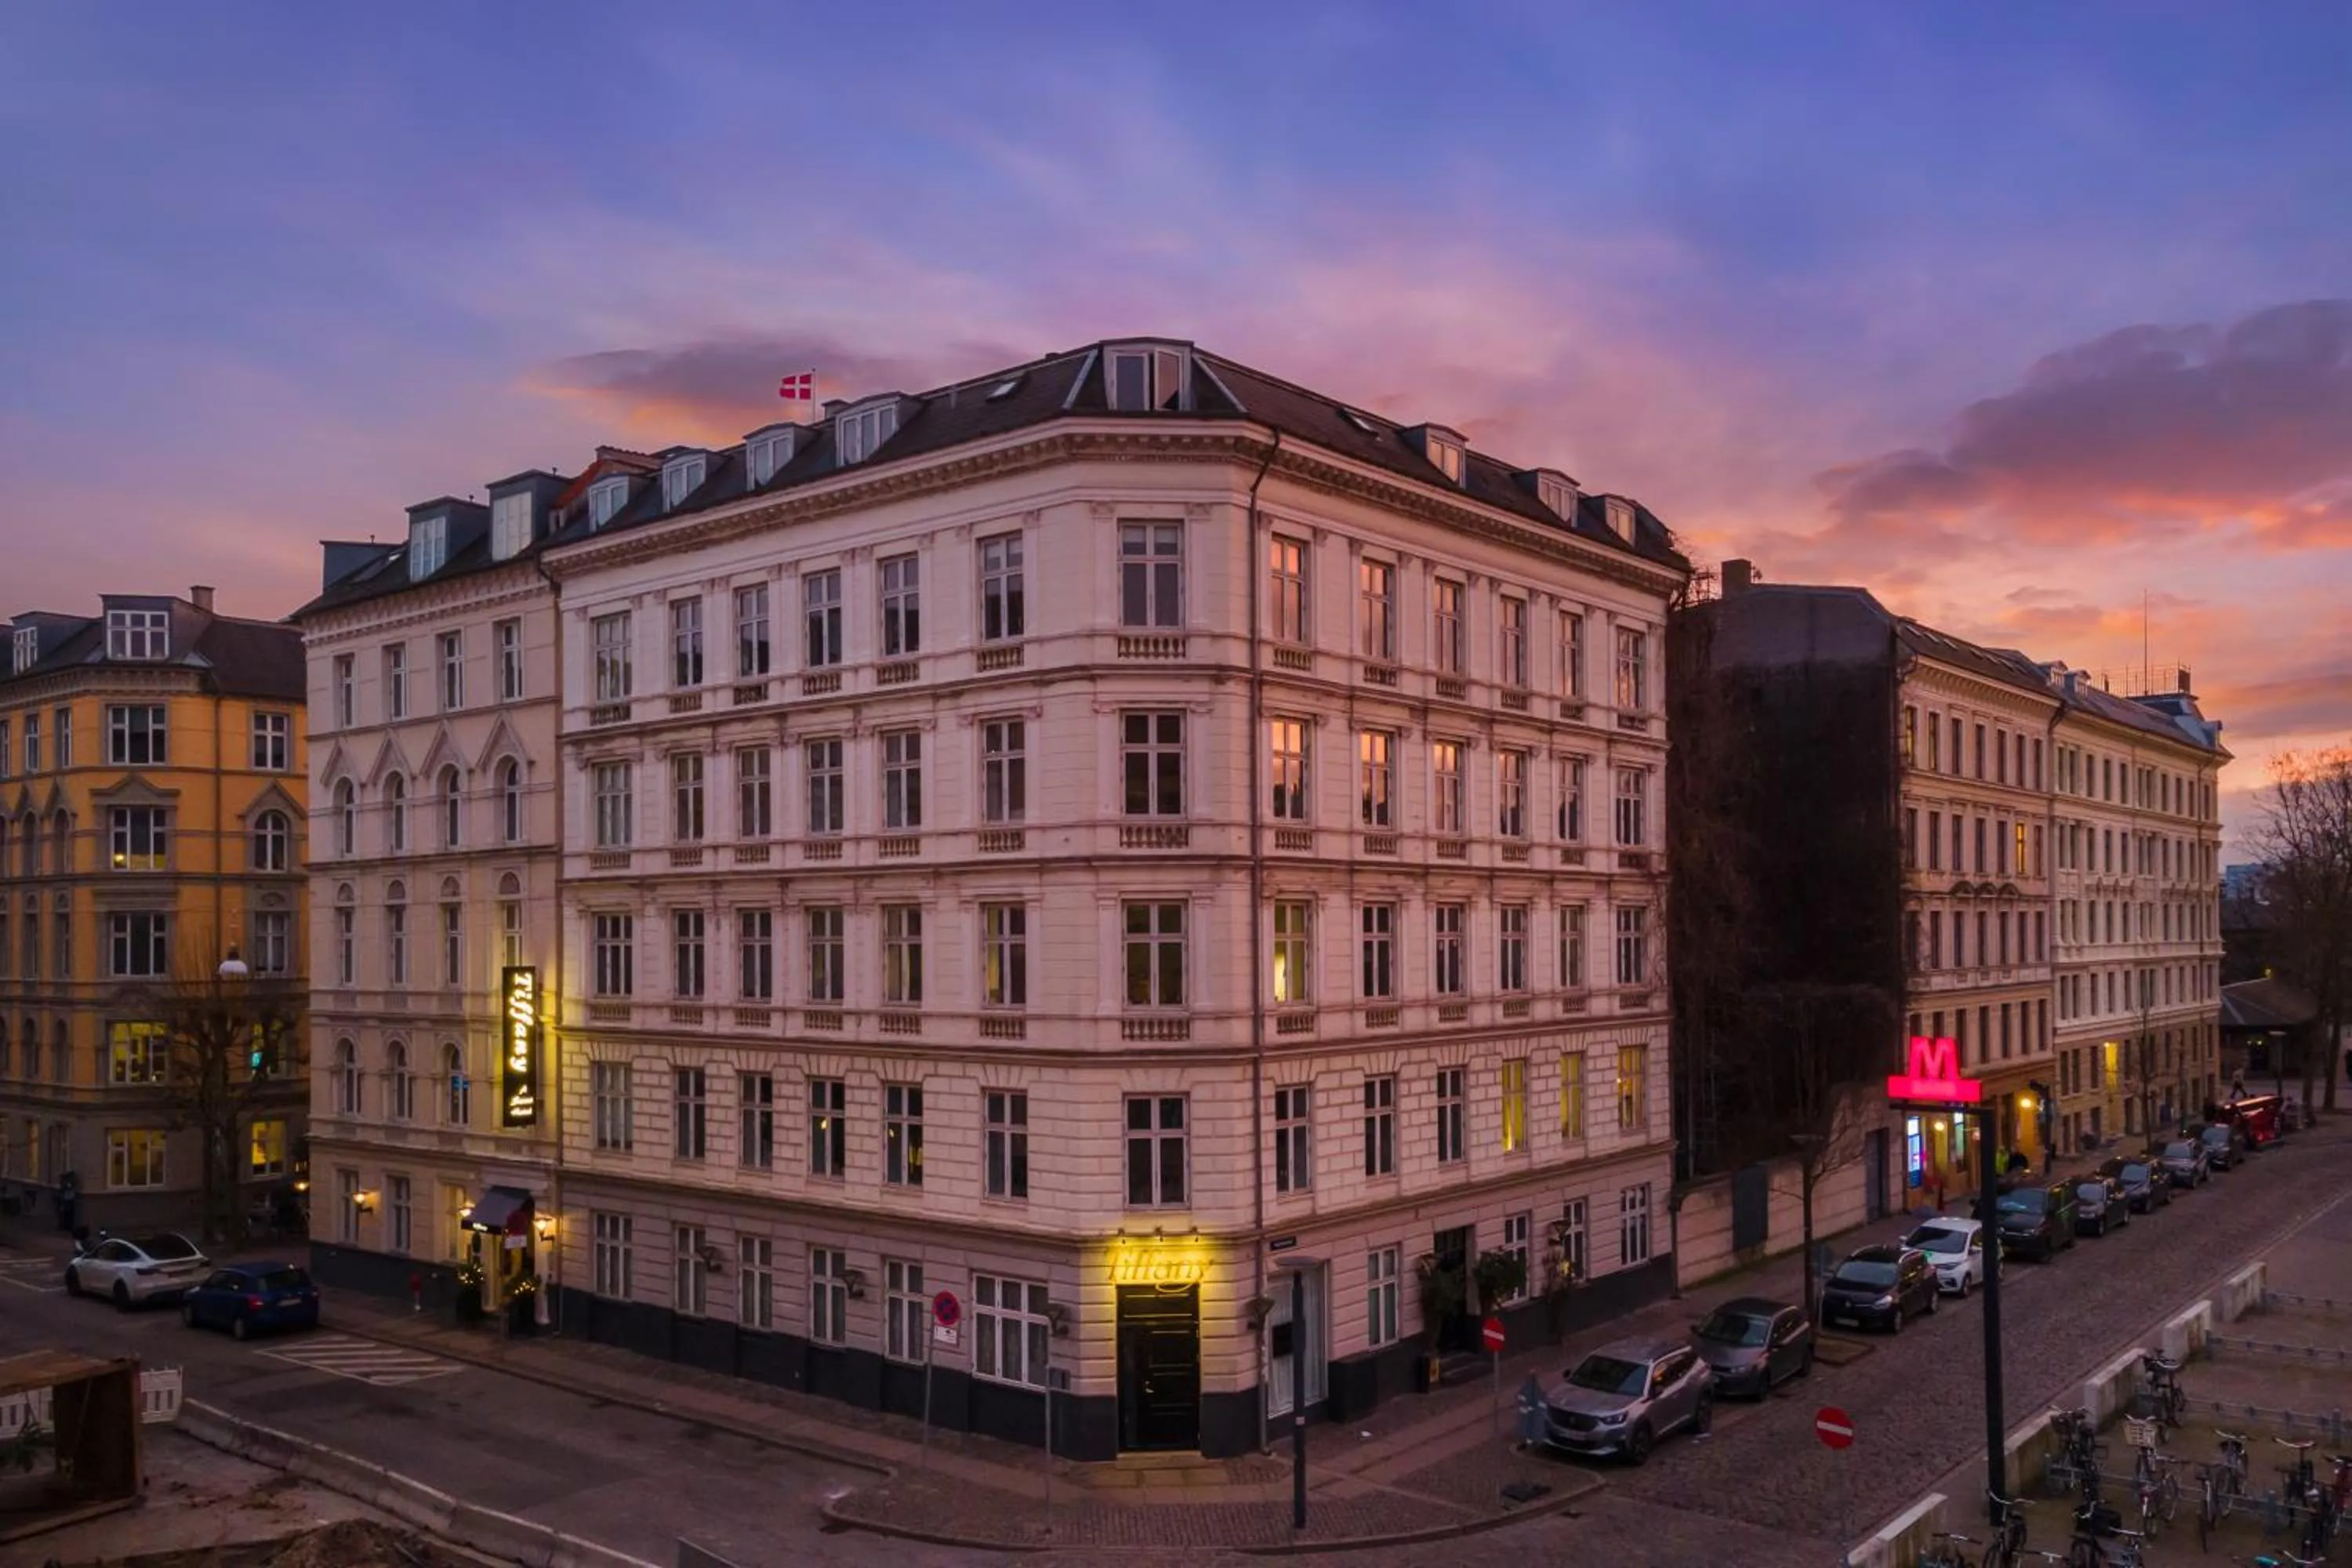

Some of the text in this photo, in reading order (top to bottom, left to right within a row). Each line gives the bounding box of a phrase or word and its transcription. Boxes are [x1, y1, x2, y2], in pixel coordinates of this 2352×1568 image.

[509, 973, 534, 1073] Tiffany
[1909, 1036, 1958, 1080] M
[1104, 1247, 1214, 1291] Tiffany
